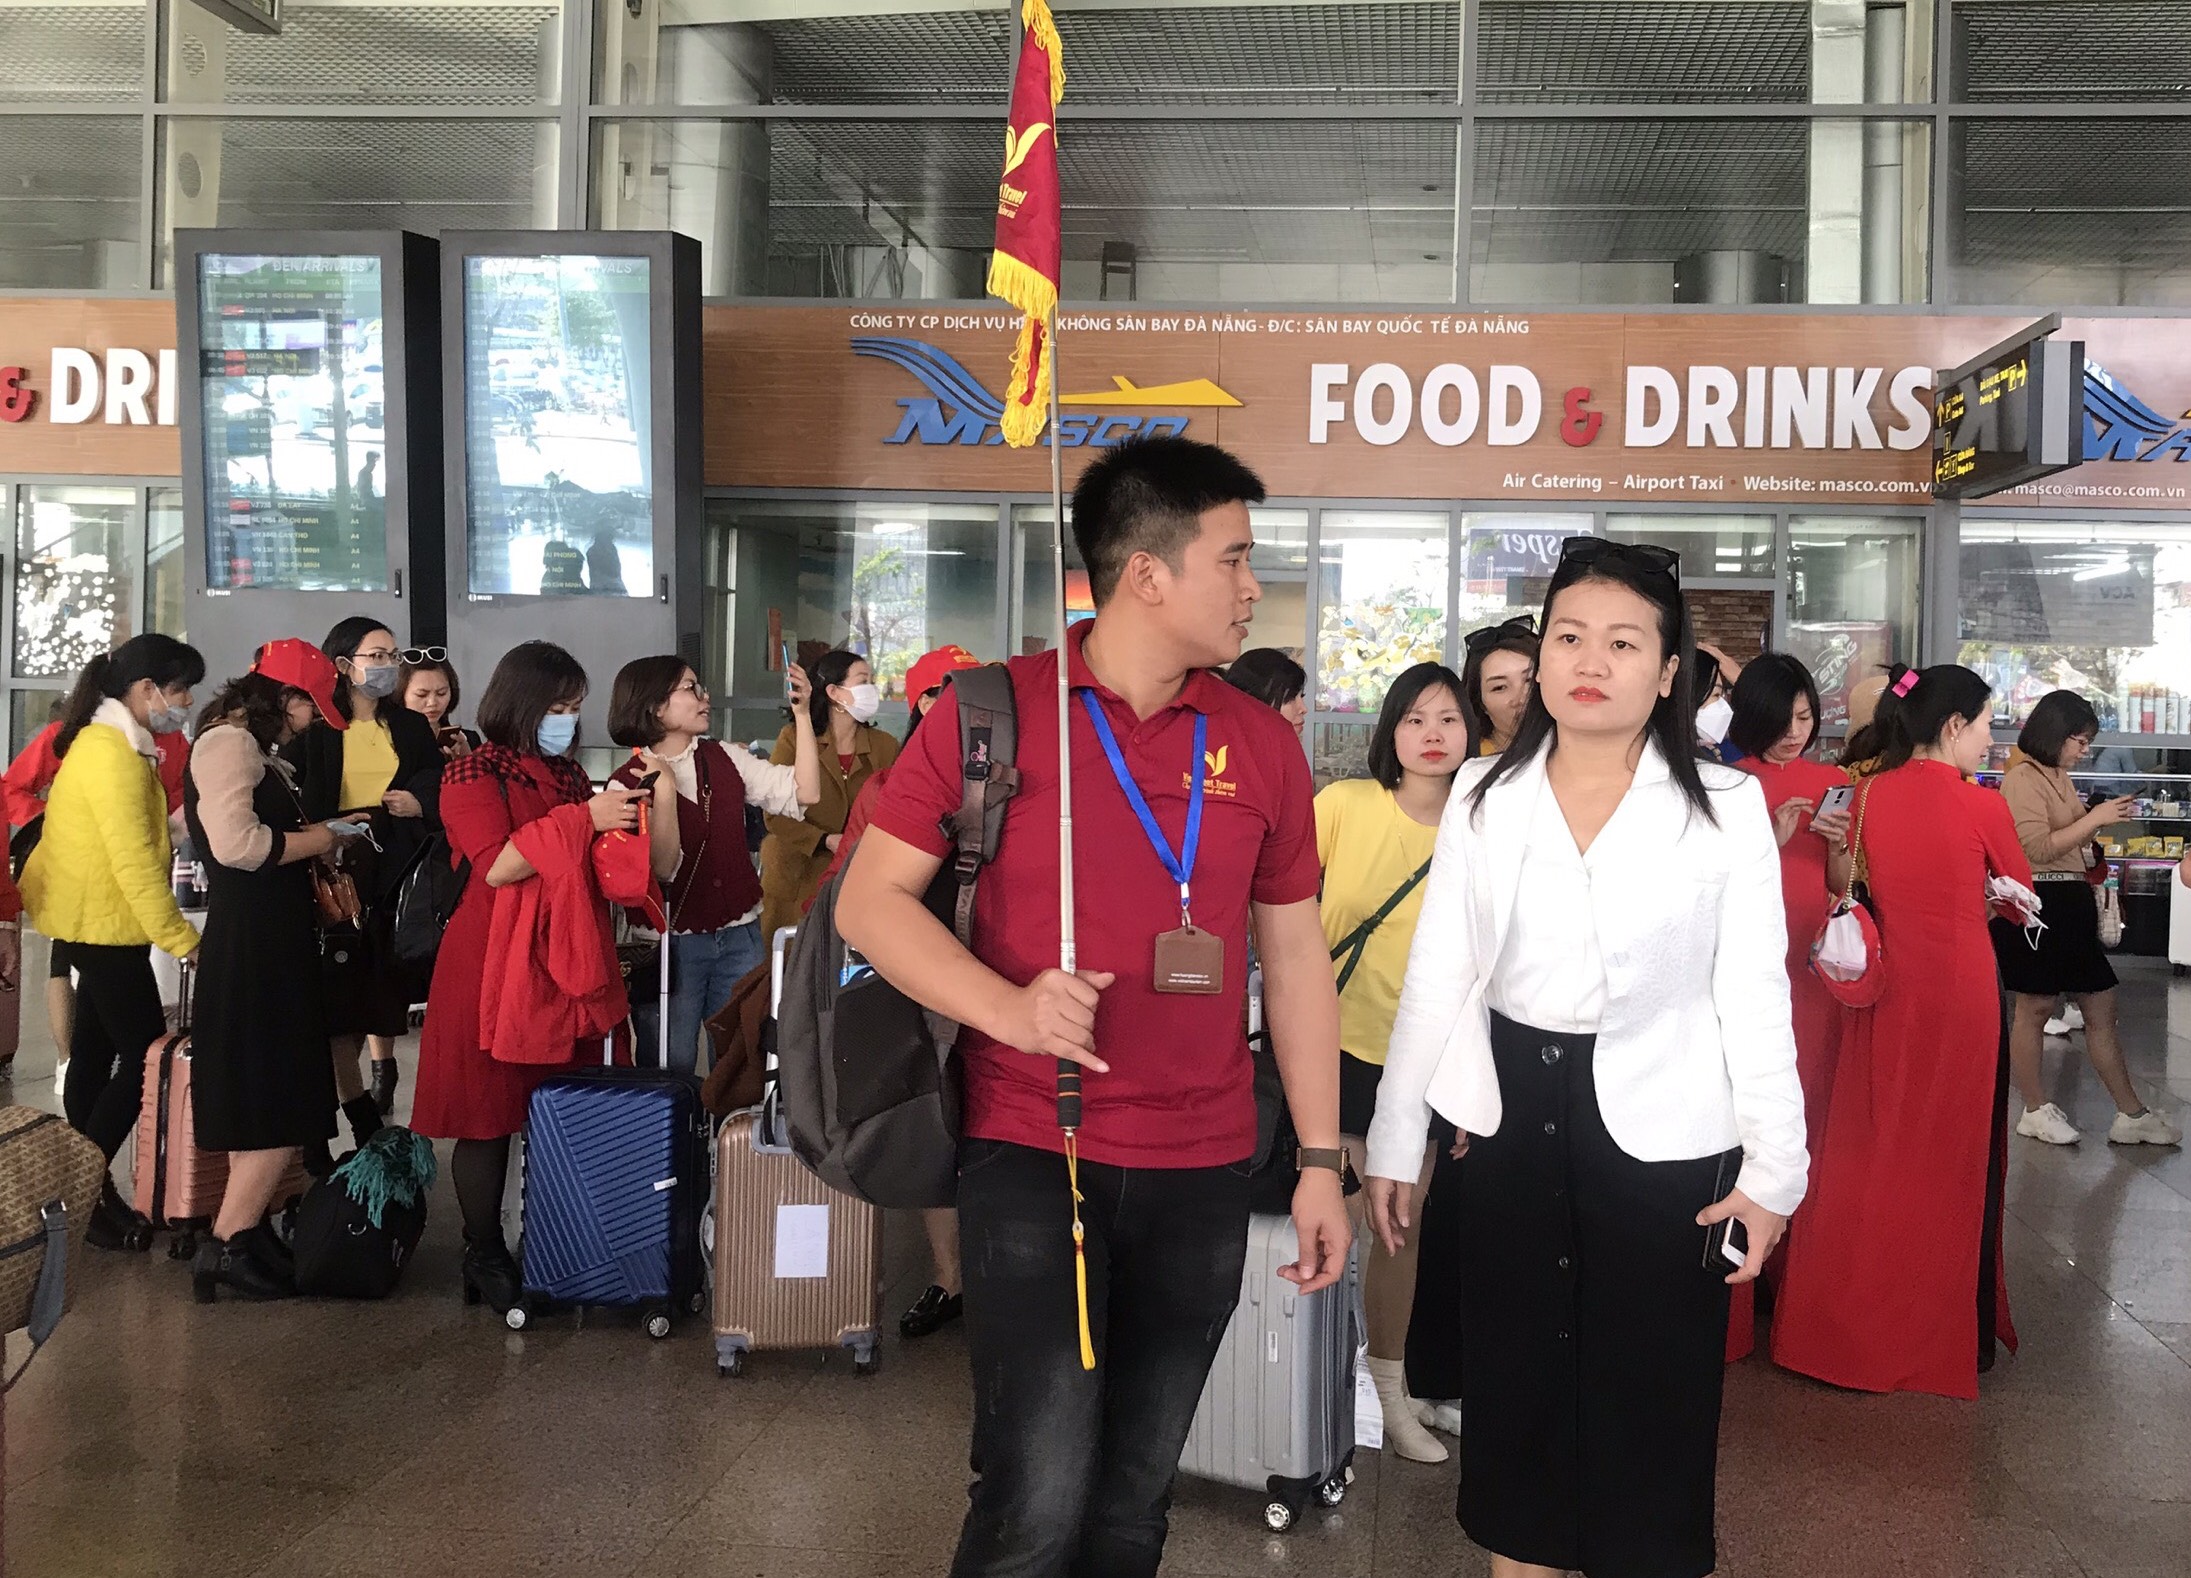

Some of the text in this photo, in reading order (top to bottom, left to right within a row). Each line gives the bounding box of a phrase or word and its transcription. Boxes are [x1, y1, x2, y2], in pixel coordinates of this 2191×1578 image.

[1003, 183, 1028, 205] Travel
[302, 260, 366, 273] ARRIVALS
[850, 311, 893, 329] CÔNG
[896, 315, 914, 329] TY
[920, 315, 940, 329] CP
[944, 316, 980, 333] DỊCH
[981, 316, 1005, 333] VỤ
[1057, 313, 1111, 331] KHÔNG
[1116, 313, 1147, 331] SÂN
[1151, 317, 1181, 332] BAY
[1184, 314, 1208, 332] ĐÀ
[1305, 317, 1338, 334] SÂN
[1343, 319, 1373, 334] BAY
[1376, 313, 1423, 336] QUỐC
[1431, 314, 1453, 334] TẾ
[1454, 316, 1478, 334] ĐÀ
[1309, 362, 1932, 451] FOOD & DRINKS
[883, 398, 1189, 447] MSCO
[1502, 473, 1526, 488] Air
[1531, 473, 1603, 493] Catering
[1623, 474, 1685, 493] Airport
[1689, 475, 1724, 491] Taxi
[1743, 475, 1816, 492] Website:
[1819, 480, 1933, 493] masco.com.v
[2014, 483, 2186, 498] masco@masco.com.vn
[350, 533, 360, 541] A4
[350, 547, 361, 555] A4
[351, 562, 361, 570] A4
[1819, 640, 1858, 685] STING
[2037, 872, 2065, 881] GUCCI
